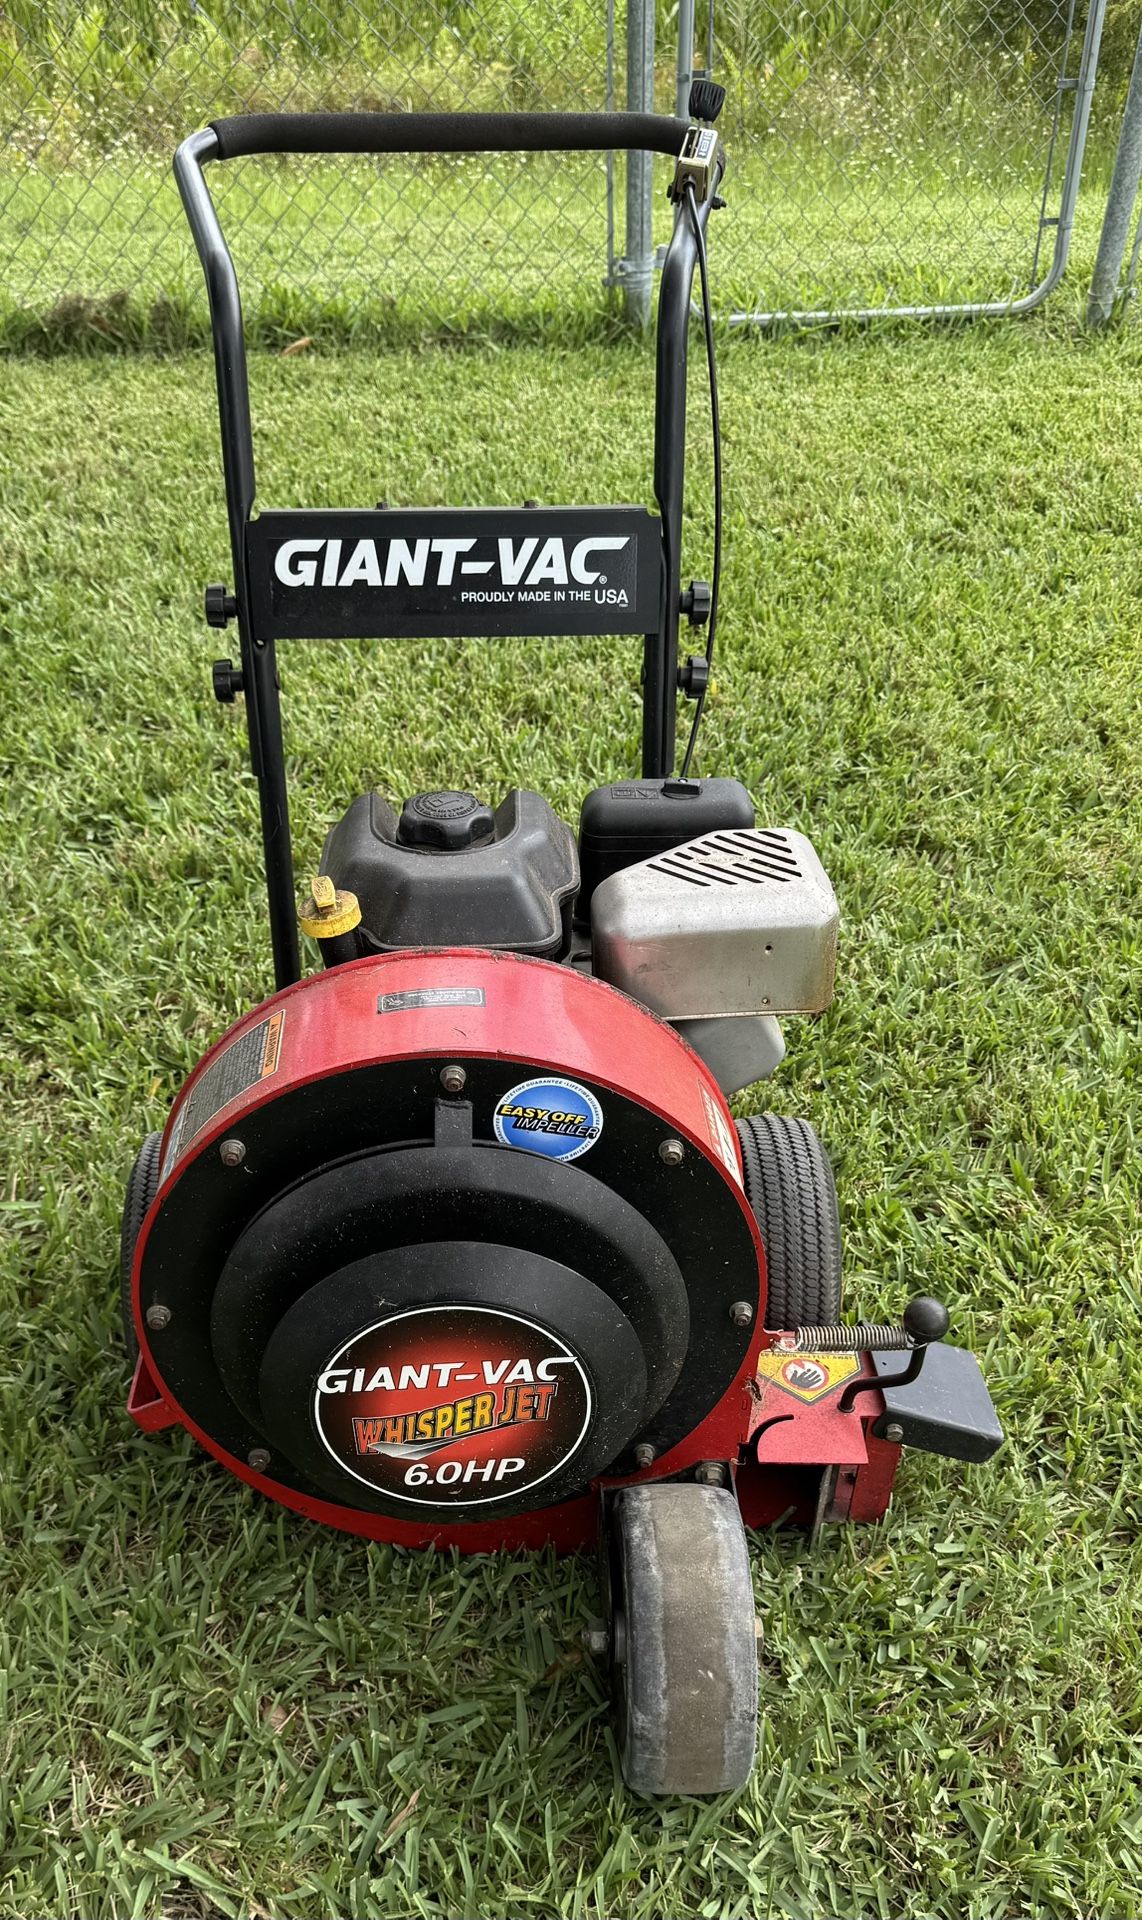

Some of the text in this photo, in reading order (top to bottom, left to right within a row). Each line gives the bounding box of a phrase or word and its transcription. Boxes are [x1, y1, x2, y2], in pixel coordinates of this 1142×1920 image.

[461, 589, 629, 604] PROUDLY MADE IN THE USA
[264, 1029, 279, 1068] WARNING
[503, 1085, 525, 1103] LIFETIME
[526, 1079, 562, 1087] GUARANTEE
[567, 1082, 590, 1098] LIFETIME
[500, 1104, 587, 1124] EASY OFF
[516, 1117, 599, 1138] IMPELLER
[317, 1356, 578, 1394] GIANT-VAC
[353, 1383, 557, 1454] WHISPER JET
[403, 1457, 526, 1486] 6.0HP
